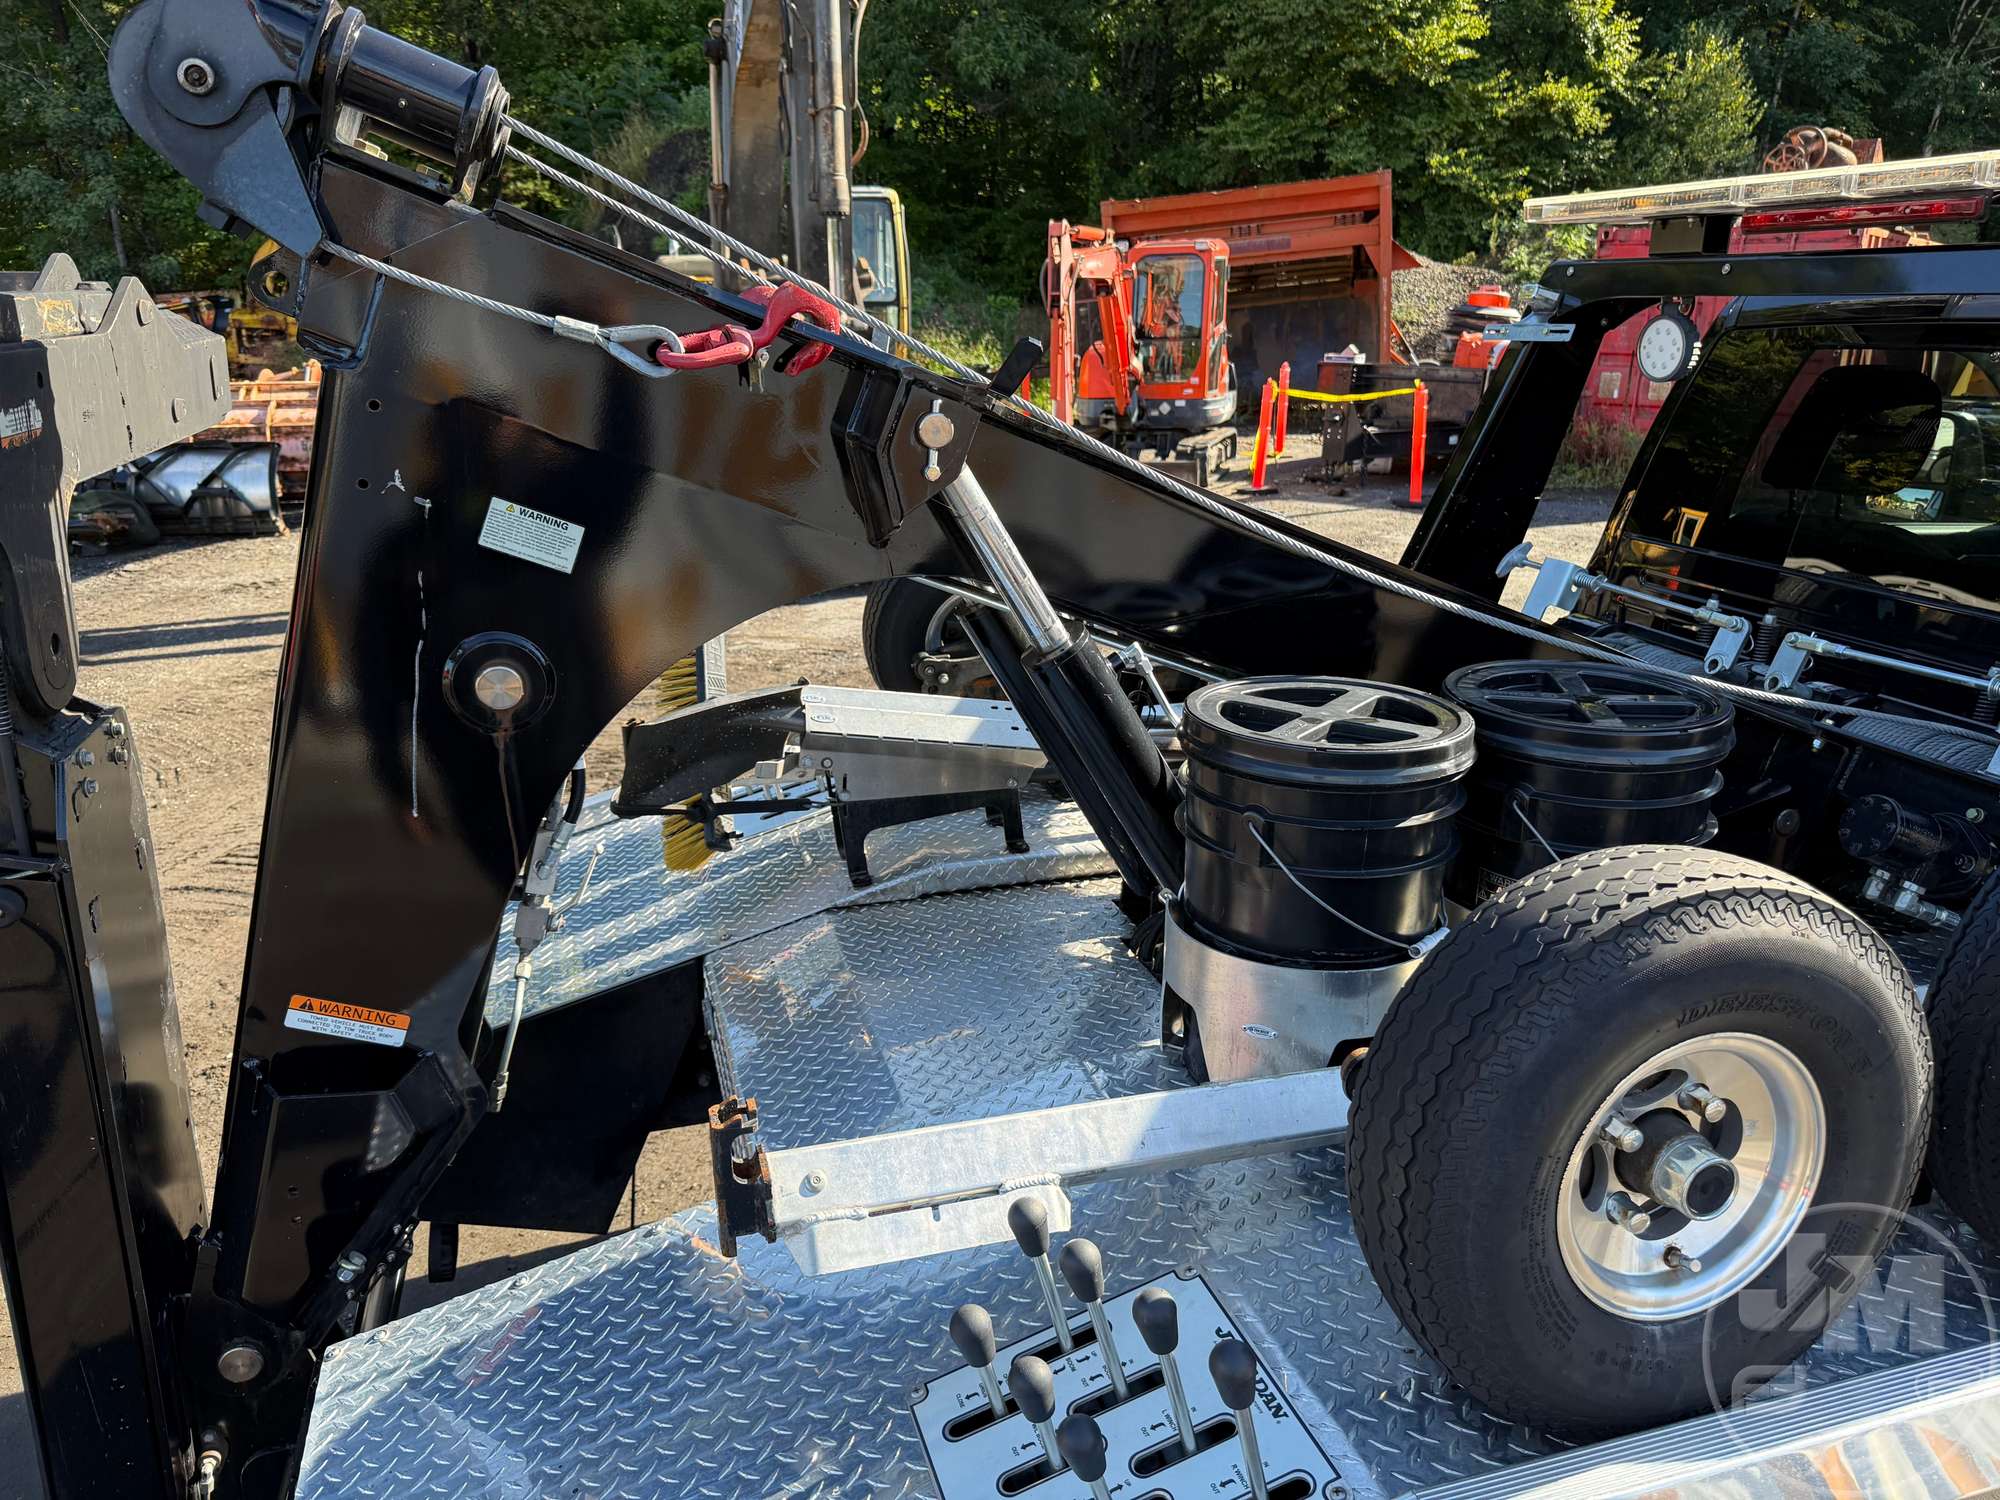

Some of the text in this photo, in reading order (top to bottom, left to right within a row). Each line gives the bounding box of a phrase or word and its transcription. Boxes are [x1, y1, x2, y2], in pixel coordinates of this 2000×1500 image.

[519, 507, 569, 531] WARNING
[310, 1014, 329, 1022] TOWED
[331, 1018, 357, 1027] VEHICLE
[318, 1000, 398, 1026] WARNING
[297, 1018, 332, 1028] CONNECTED
[358, 1028, 376, 1036] TRUCK
[311, 1025, 377, 1041] WITH SAFETY CHAINS
[1065, 1357, 1077, 1372] BOOM
[1215, 1326, 1289, 1418] JDAN
[1080, 1377, 1090, 1387] OUT
[1164, 1413, 1177, 1432] WINCH
[1140, 1426, 1151, 1437] OUT
[1011, 1446, 1020, 1457] OUT
[1234, 1468, 1249, 1490] WINCH
[1210, 1482, 1221, 1494] OUT
